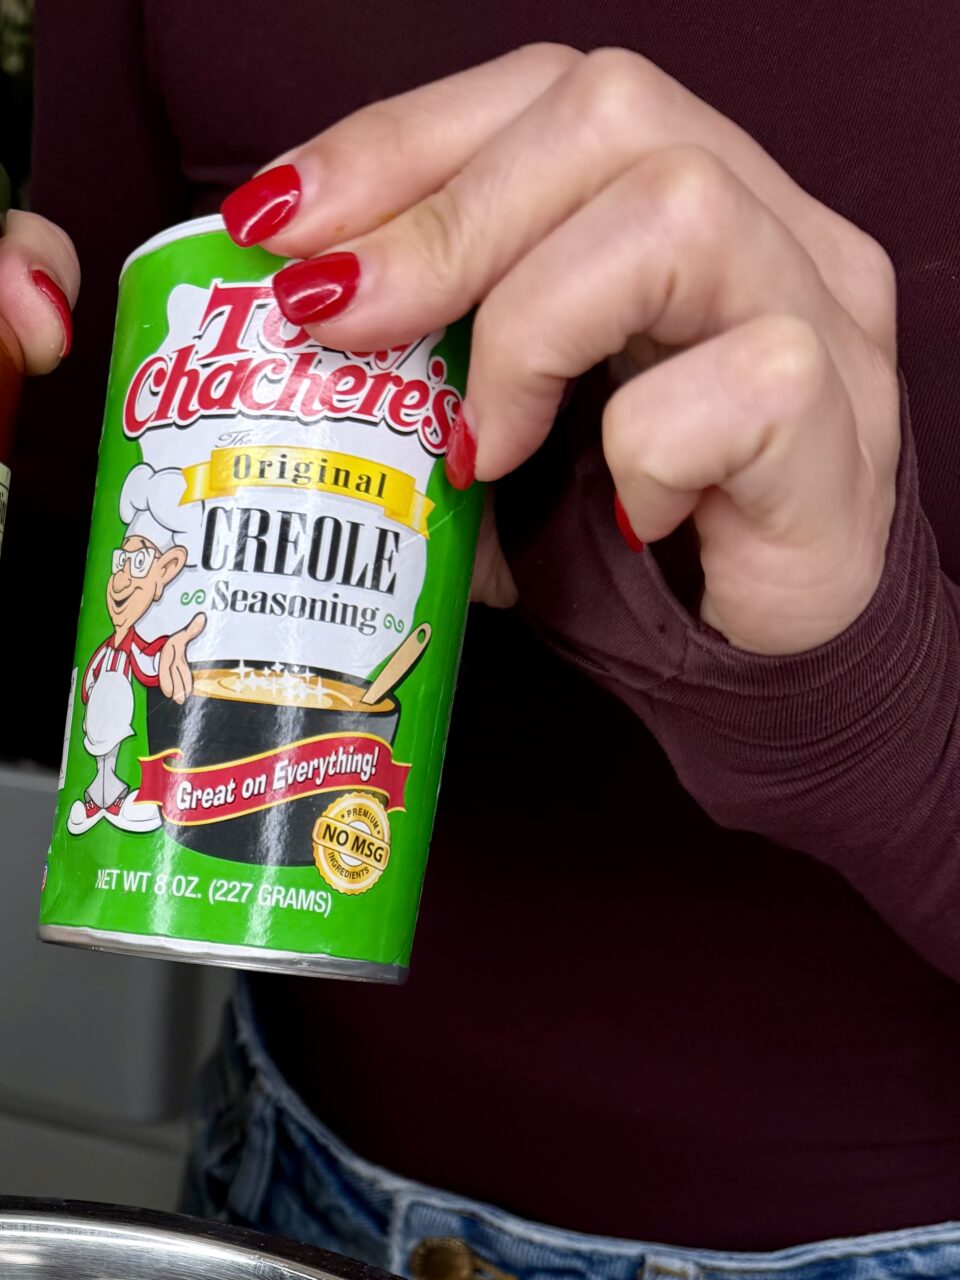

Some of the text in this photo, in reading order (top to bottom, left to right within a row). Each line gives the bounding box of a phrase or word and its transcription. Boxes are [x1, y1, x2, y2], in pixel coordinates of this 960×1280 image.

[232, 453, 387, 500] Original
[202, 505, 401, 595] CREOLE
[211, 580, 380, 634] Seasoning
[175, 745, 379, 811] Great on Everything!
[346, 807, 379, 830] PREMIUM
[322, 823, 384, 863] NO MSG
[327, 851, 370, 880] INGREDIENTS
[95, 869, 333, 918] NET WT 8 OZ. (227 GRAMS)
